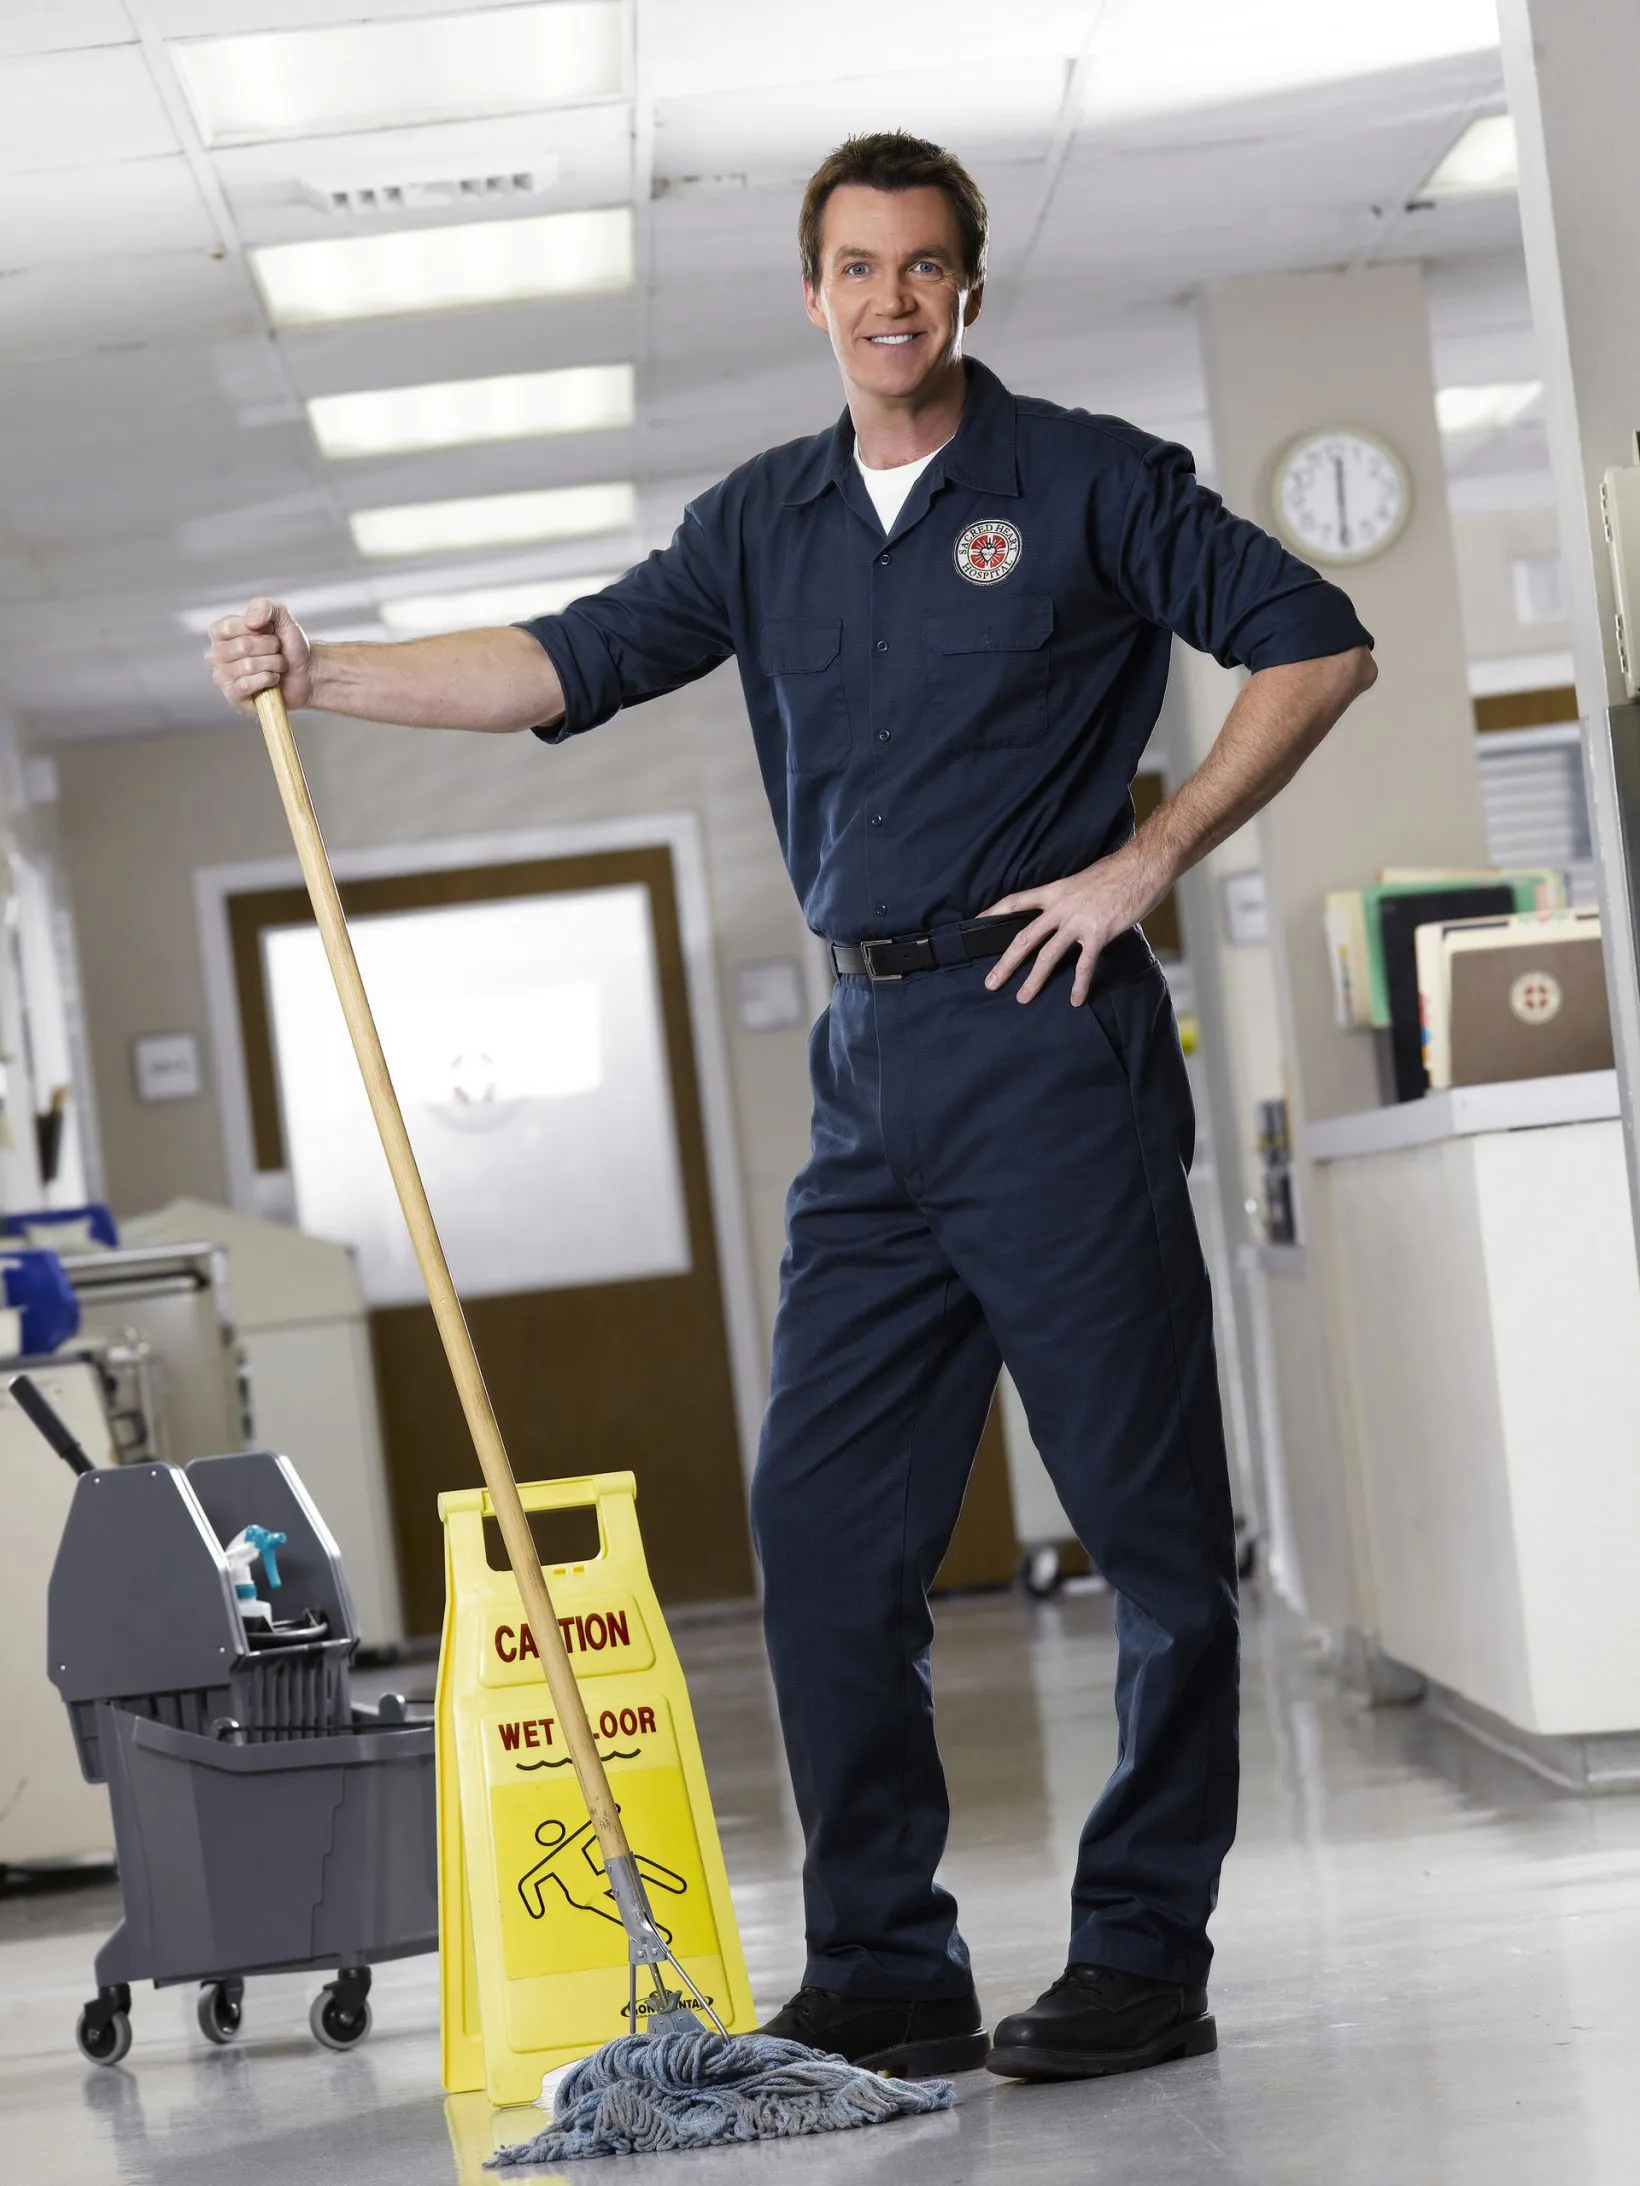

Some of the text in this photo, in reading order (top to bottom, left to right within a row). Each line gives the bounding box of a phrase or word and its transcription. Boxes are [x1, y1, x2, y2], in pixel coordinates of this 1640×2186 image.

[959, 524, 1018, 555] SACRED HEART
[961, 560, 1013, 580] HOSPITAL
[494, 1610, 631, 1663] CATION
[498, 1706, 657, 1751] WET OOR
